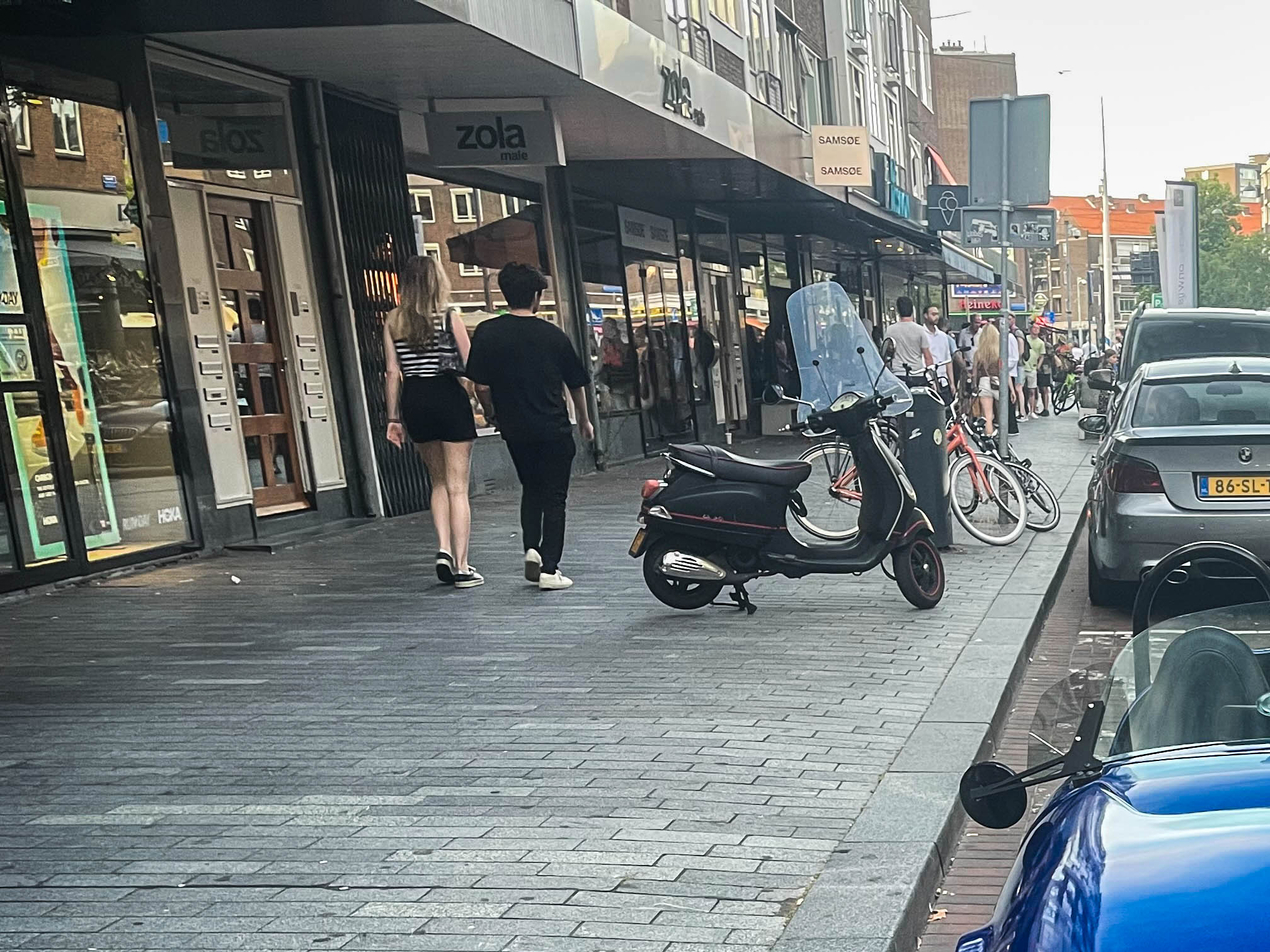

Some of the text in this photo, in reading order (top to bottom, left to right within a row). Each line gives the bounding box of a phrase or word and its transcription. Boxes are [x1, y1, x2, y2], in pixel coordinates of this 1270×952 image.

[455, 116, 526, 150] zola
[818, 135, 861, 145] SAMSØE
[500, 150, 528, 161] male
[820, 166, 863, 176] SAMSØE
[157, 506, 182, 524] HOKA
